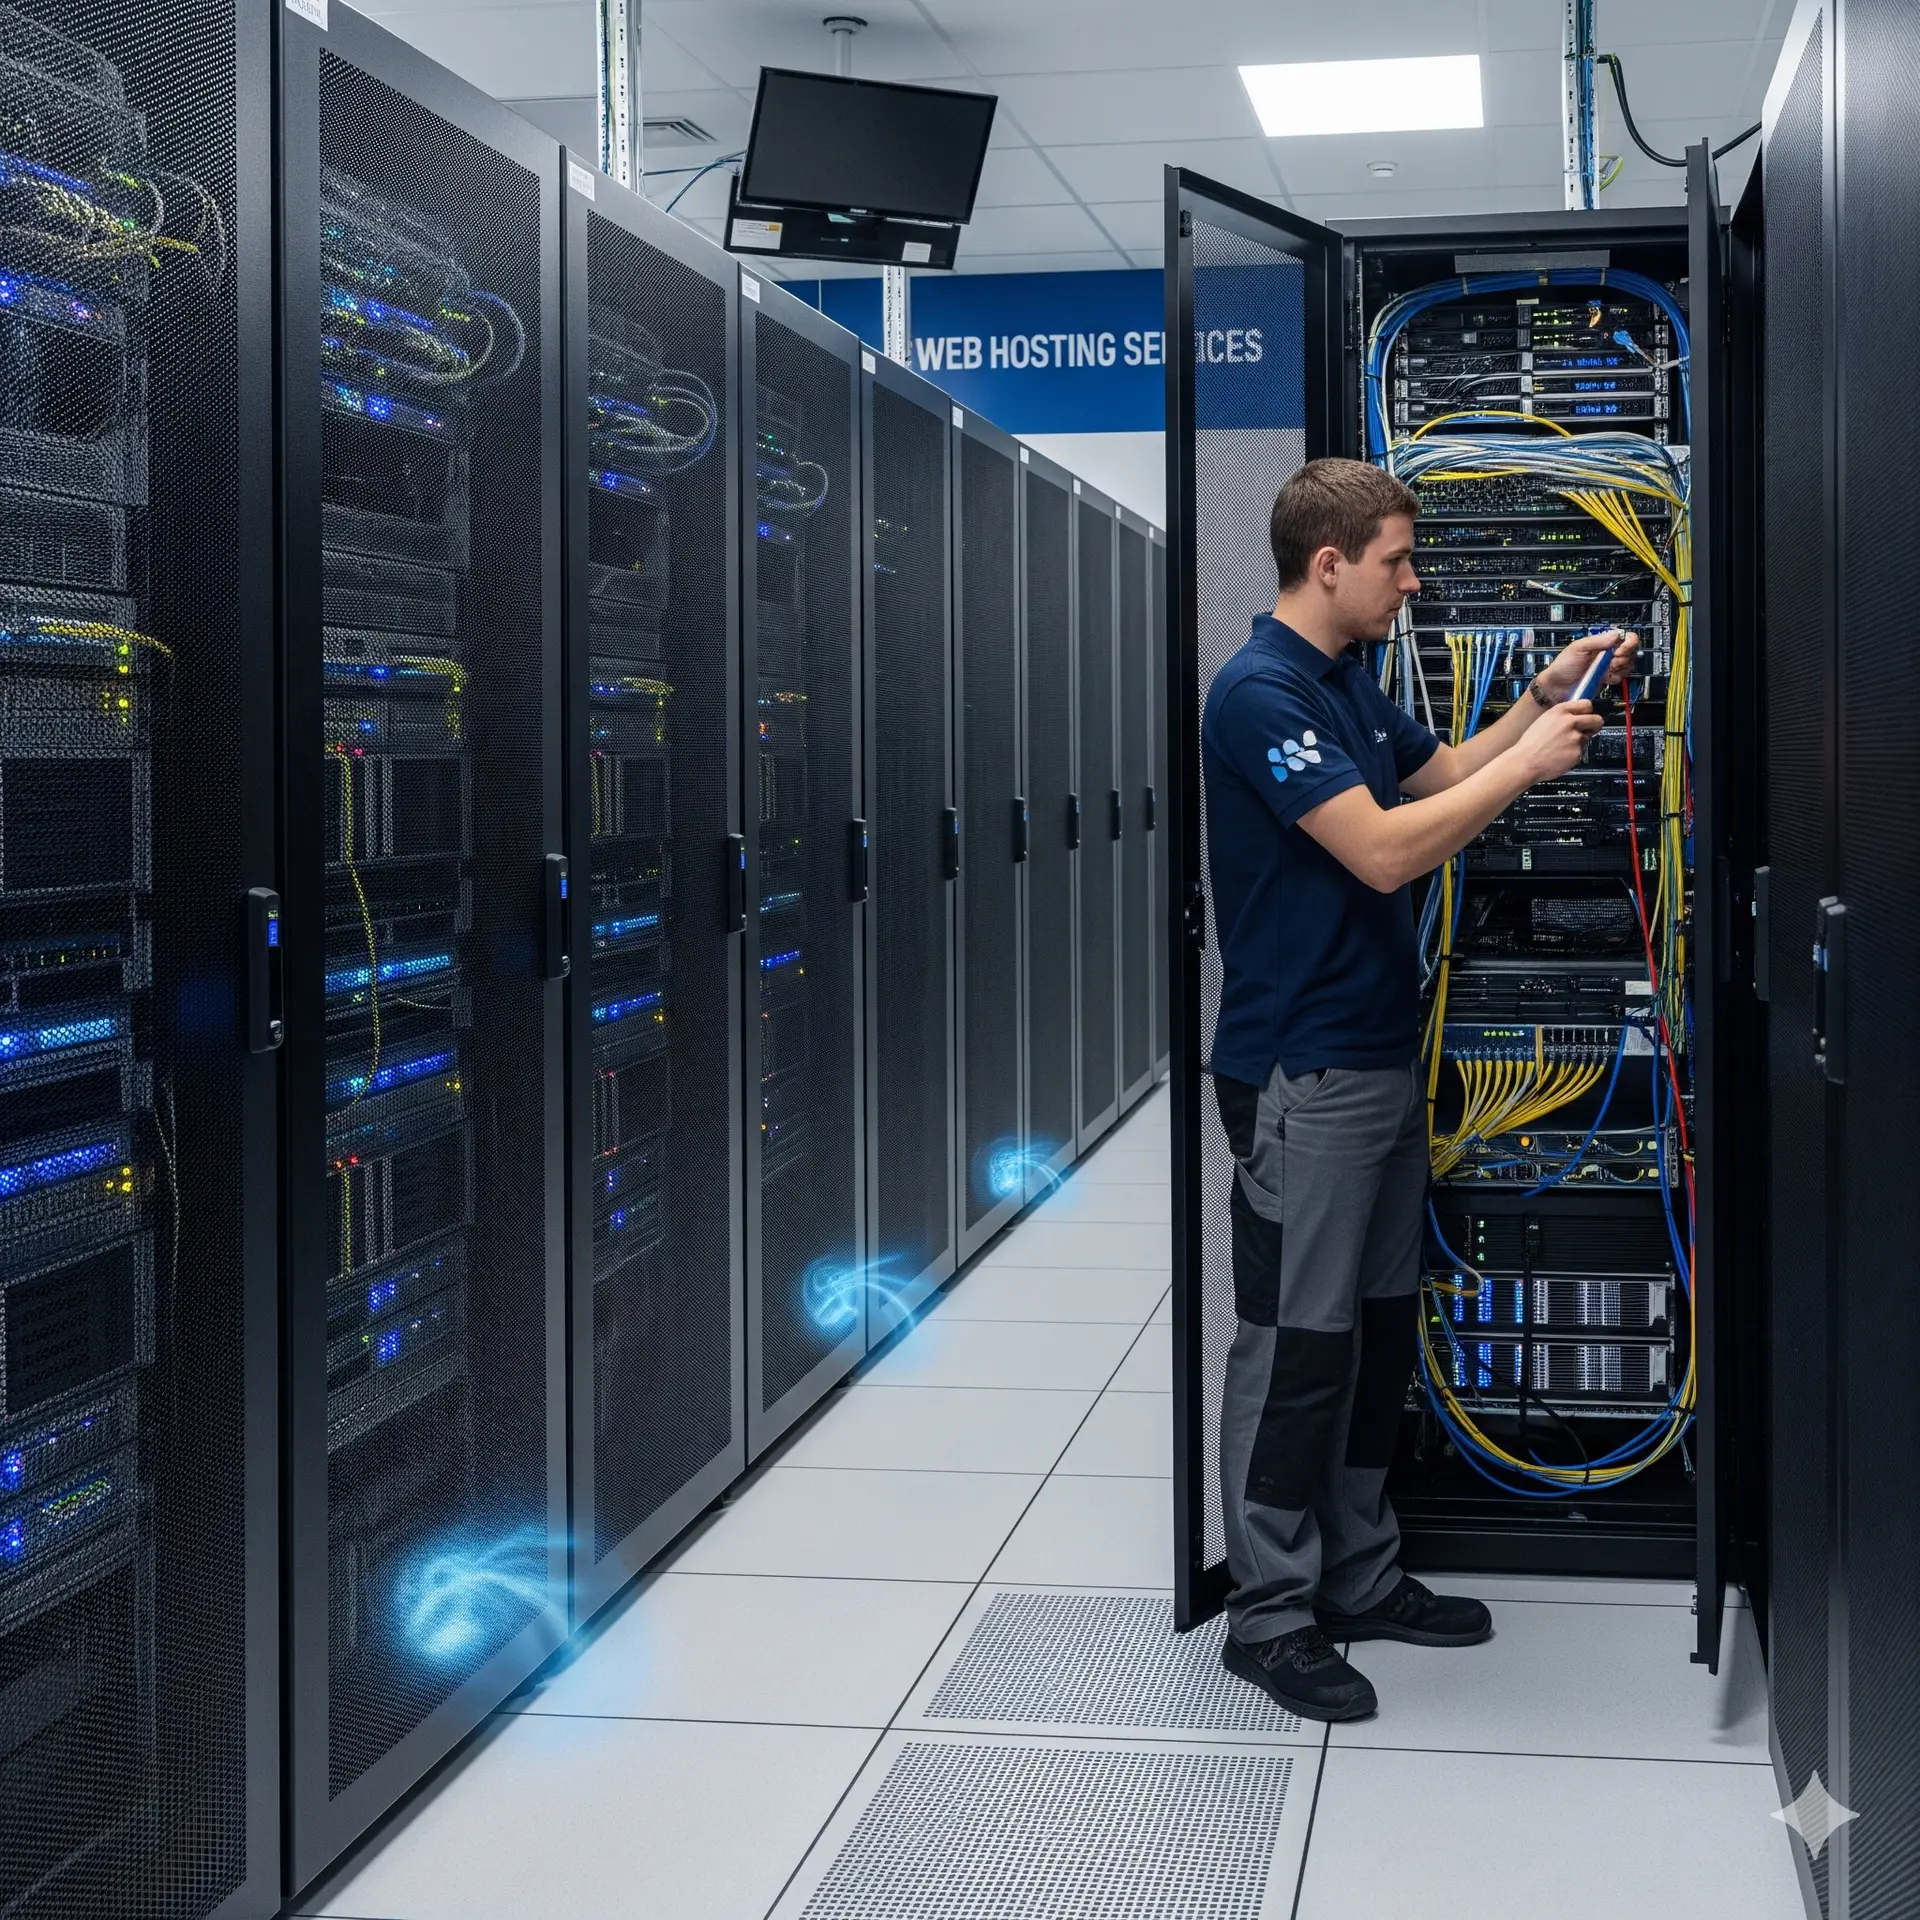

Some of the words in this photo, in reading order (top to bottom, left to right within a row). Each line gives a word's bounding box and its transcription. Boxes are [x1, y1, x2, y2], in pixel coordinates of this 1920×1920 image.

[915, 336, 983, 371] WEB
[990, 332, 1116, 369] HOSTING
[1123, 329, 1263, 366] SEICES
